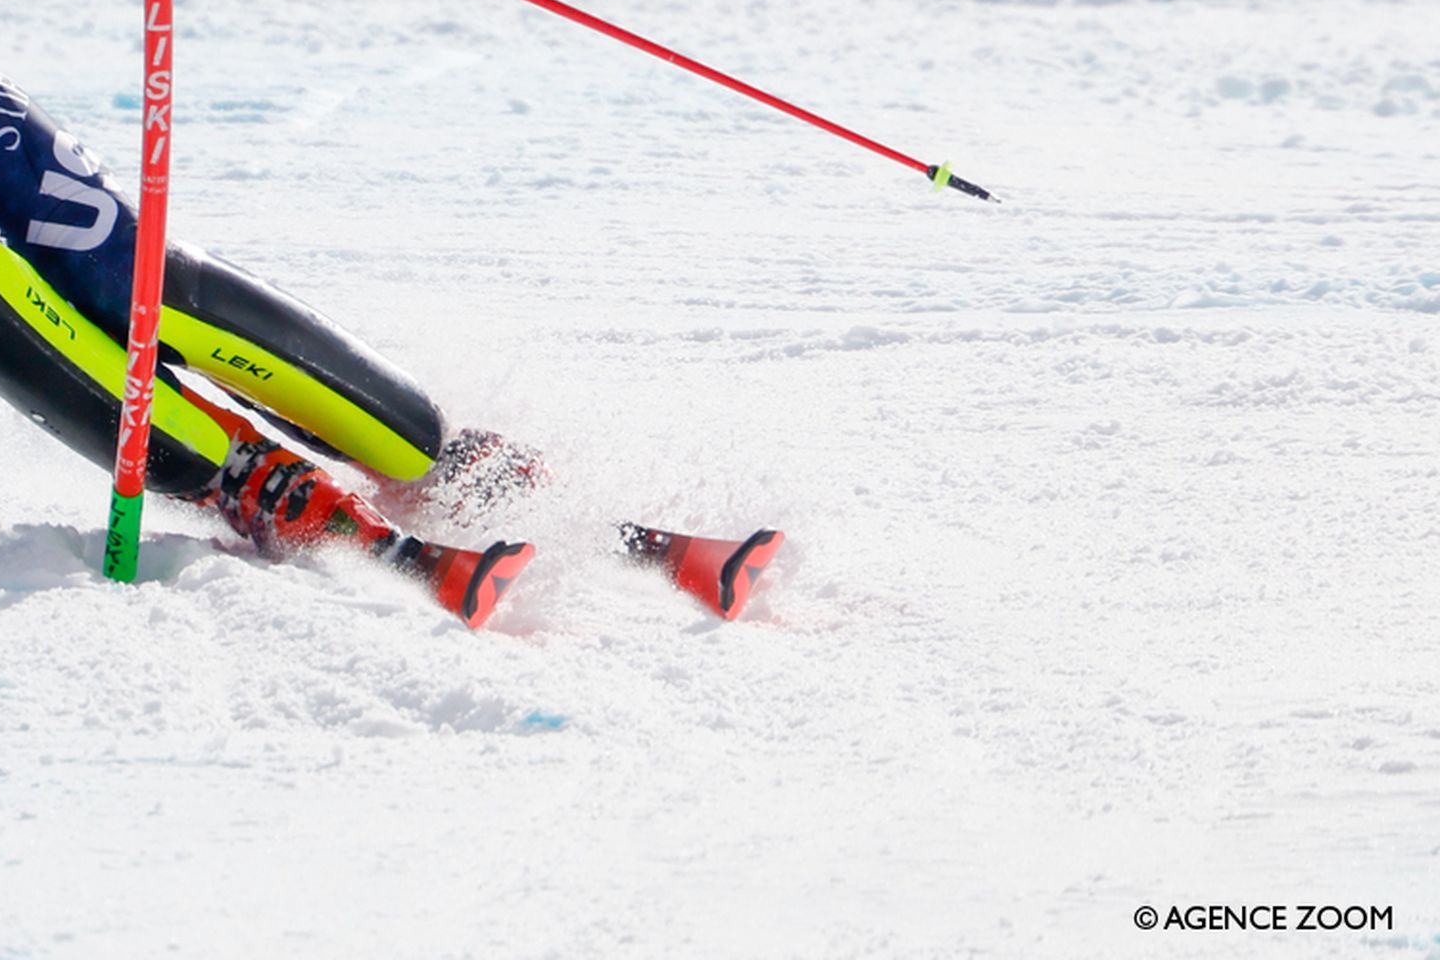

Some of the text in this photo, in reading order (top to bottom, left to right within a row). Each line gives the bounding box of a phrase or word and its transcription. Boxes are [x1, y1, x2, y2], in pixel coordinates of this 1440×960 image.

[146, 2, 171, 164] LISKI
[26, 286, 75, 340] LEKI
[211, 347, 273, 381] LEKI
